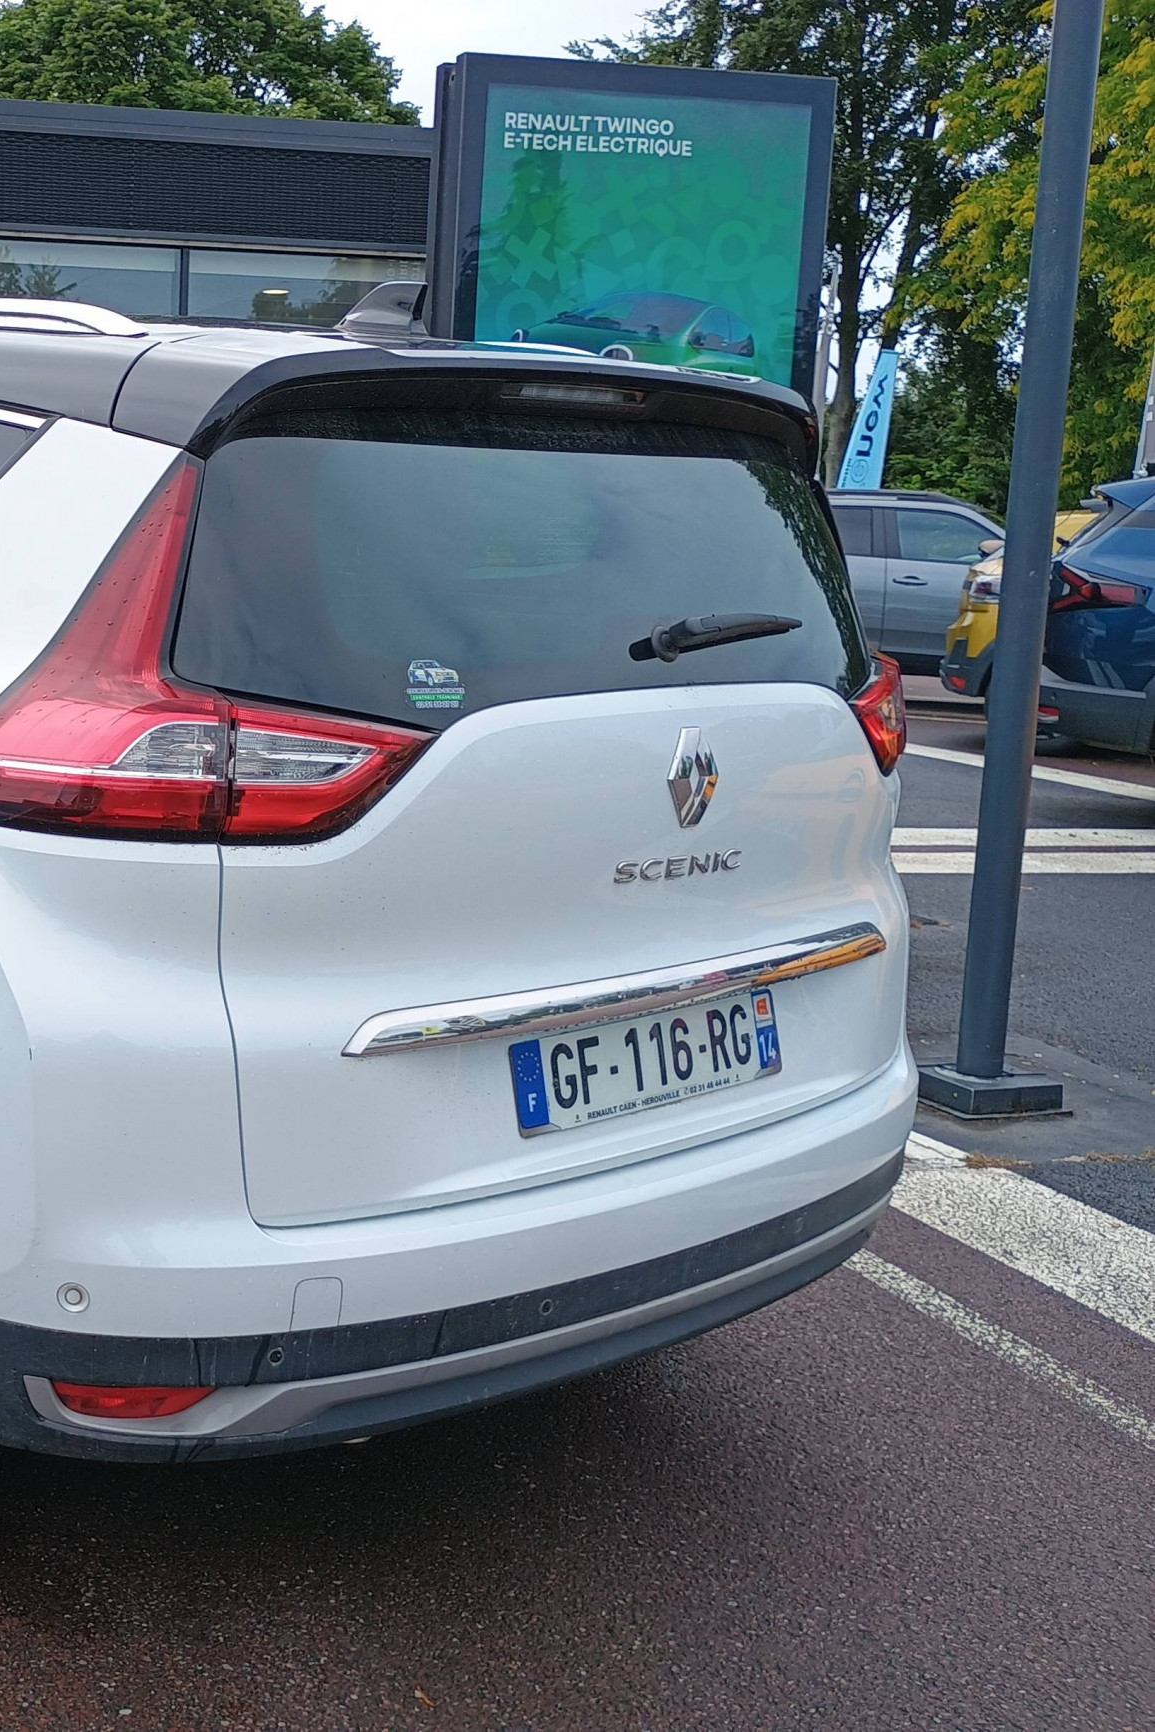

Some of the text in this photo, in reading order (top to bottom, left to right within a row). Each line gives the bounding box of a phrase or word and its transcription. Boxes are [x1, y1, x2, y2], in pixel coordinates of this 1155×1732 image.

[504, 112, 674, 136] RENAULT TWINGO
[503, 132, 693, 158] E-TECH ELECTRIQUE
[613, 848, 742, 884] SCENIC
[550, 1004, 752, 1110] GF-116-RG
[759, 1032, 777, 1062] 14
[527, 1093, 537, 1113] F
[587, 1105, 617, 1120] RENAULT
[619, 1102, 637, 1112] CAEN
[641, 1090, 680, 1107] HEROUVILLE
